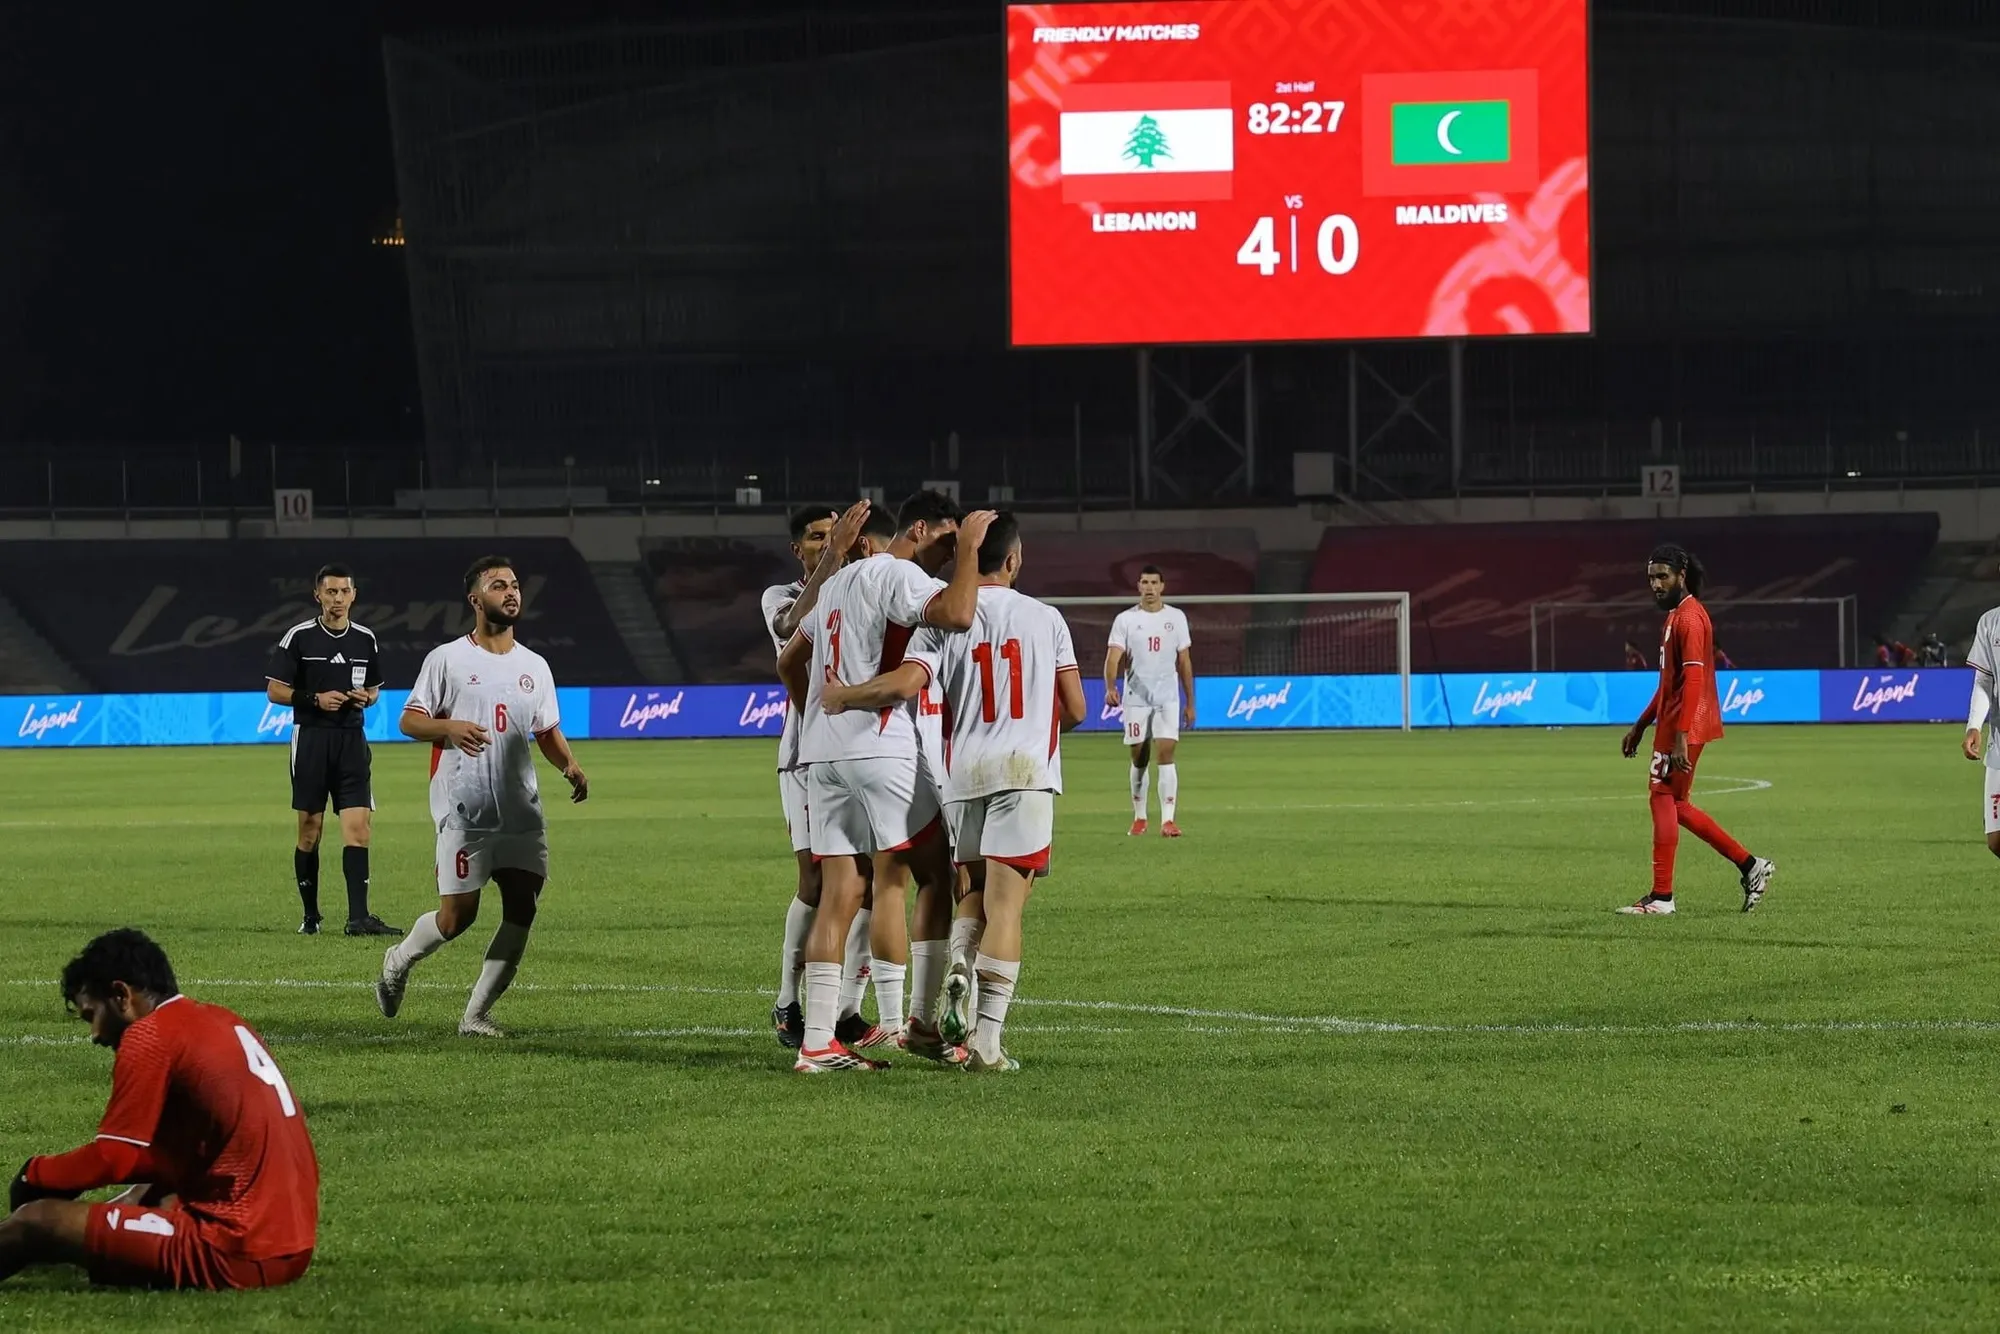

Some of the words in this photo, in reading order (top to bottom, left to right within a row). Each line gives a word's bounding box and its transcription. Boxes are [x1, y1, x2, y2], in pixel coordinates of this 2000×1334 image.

[1033, 25, 1115, 43] FRIENDLY
[1115, 23, 1200, 41] MATCHES
[1247, 101, 1345, 134] 82:27
[1092, 210, 1197, 232] LEBANON
[1396, 203, 1508, 225] MALDIVES
[1236, 216, 1281, 276] 4
[1317, 214, 1359, 275] 0
[1649, 469, 1674, 492] 12
[281, 494, 307, 516] 10
[1148, 636, 1161, 652] 18
[971, 638, 1024, 723] 11
[495, 703, 507, 733] 6
[739, 692, 787, 729] Legen
[1128, 722, 1141, 737] 18
[455, 850, 470, 880] 6
[234, 1025, 297, 1118] 4
[123, 1211, 176, 1237] 4
